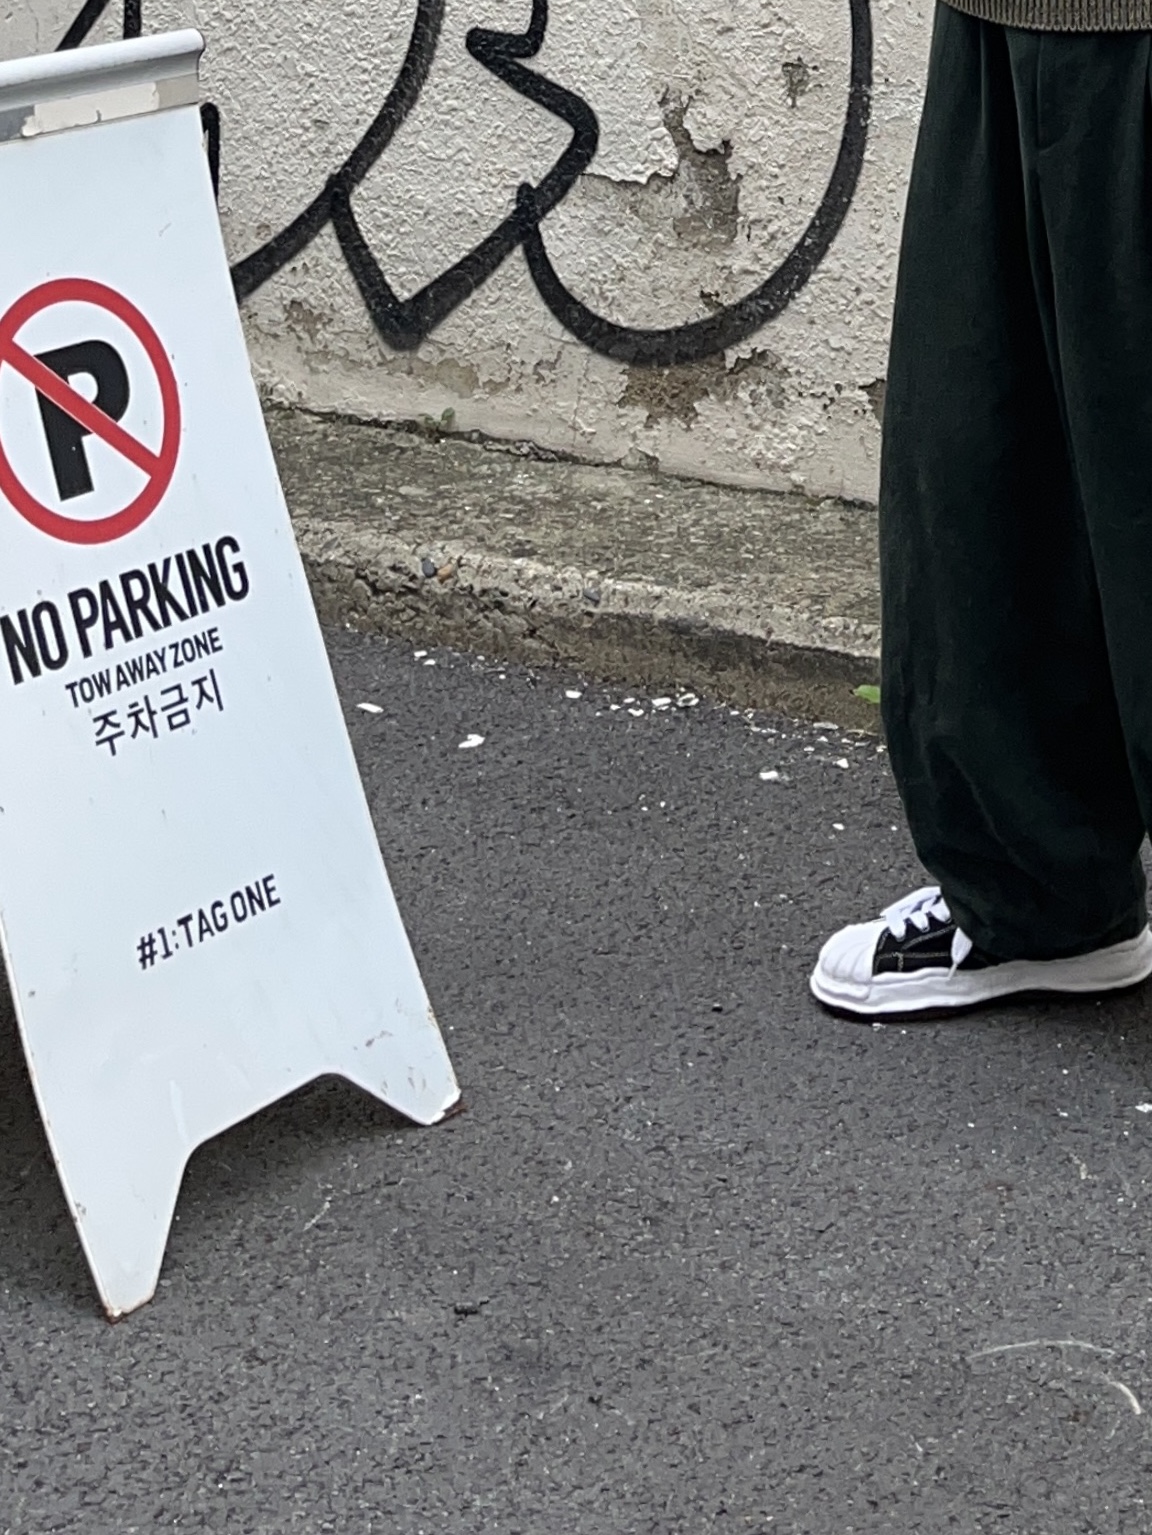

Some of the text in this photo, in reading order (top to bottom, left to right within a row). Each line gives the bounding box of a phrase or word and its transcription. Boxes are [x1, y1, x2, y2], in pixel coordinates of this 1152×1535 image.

[34, 339, 130, 502] P
[0, 535, 250, 686] NO PARKING
[65, 627, 224, 708] TOW AWAY ZONE
[92, 668, 225, 757] 주차금지
[136, 873, 281, 971] #1:TAG ONE
